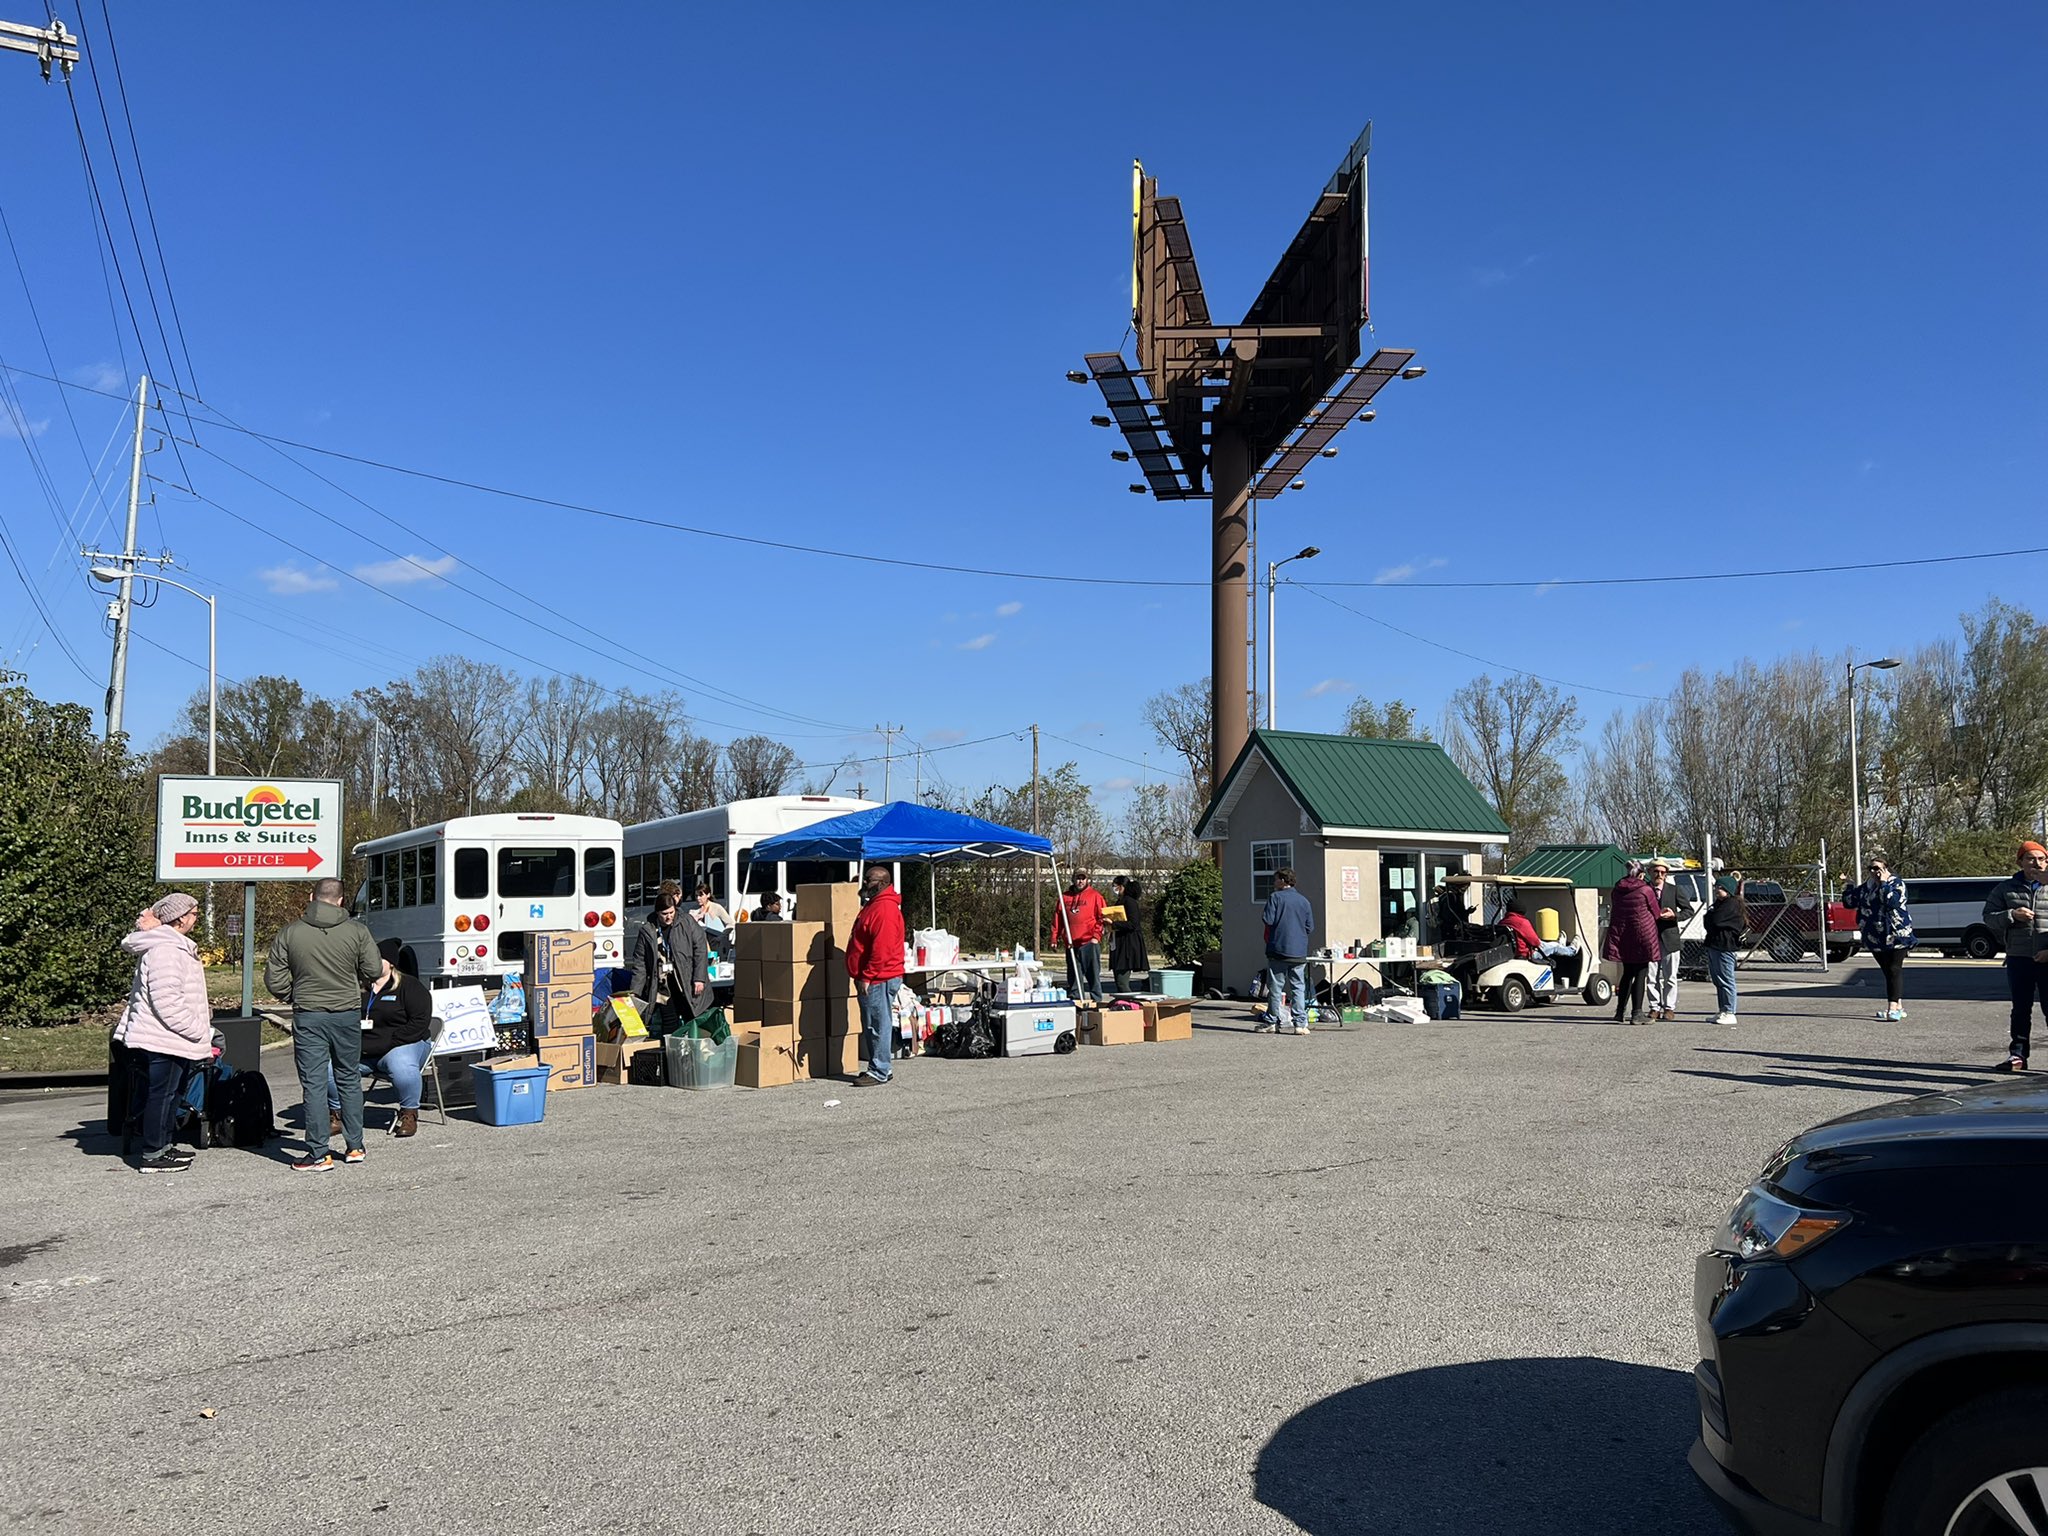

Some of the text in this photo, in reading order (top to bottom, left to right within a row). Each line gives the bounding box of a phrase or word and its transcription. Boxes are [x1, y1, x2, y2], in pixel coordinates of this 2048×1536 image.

[182, 795, 321, 827] Budgetel
[185, 831, 317, 843] Inns & Suites
[223, 855, 285, 866] OFFICE
[541, 938, 549, 971] medium
[539, 991, 547, 1023] medium
[584, 1050, 592, 1082] medium
